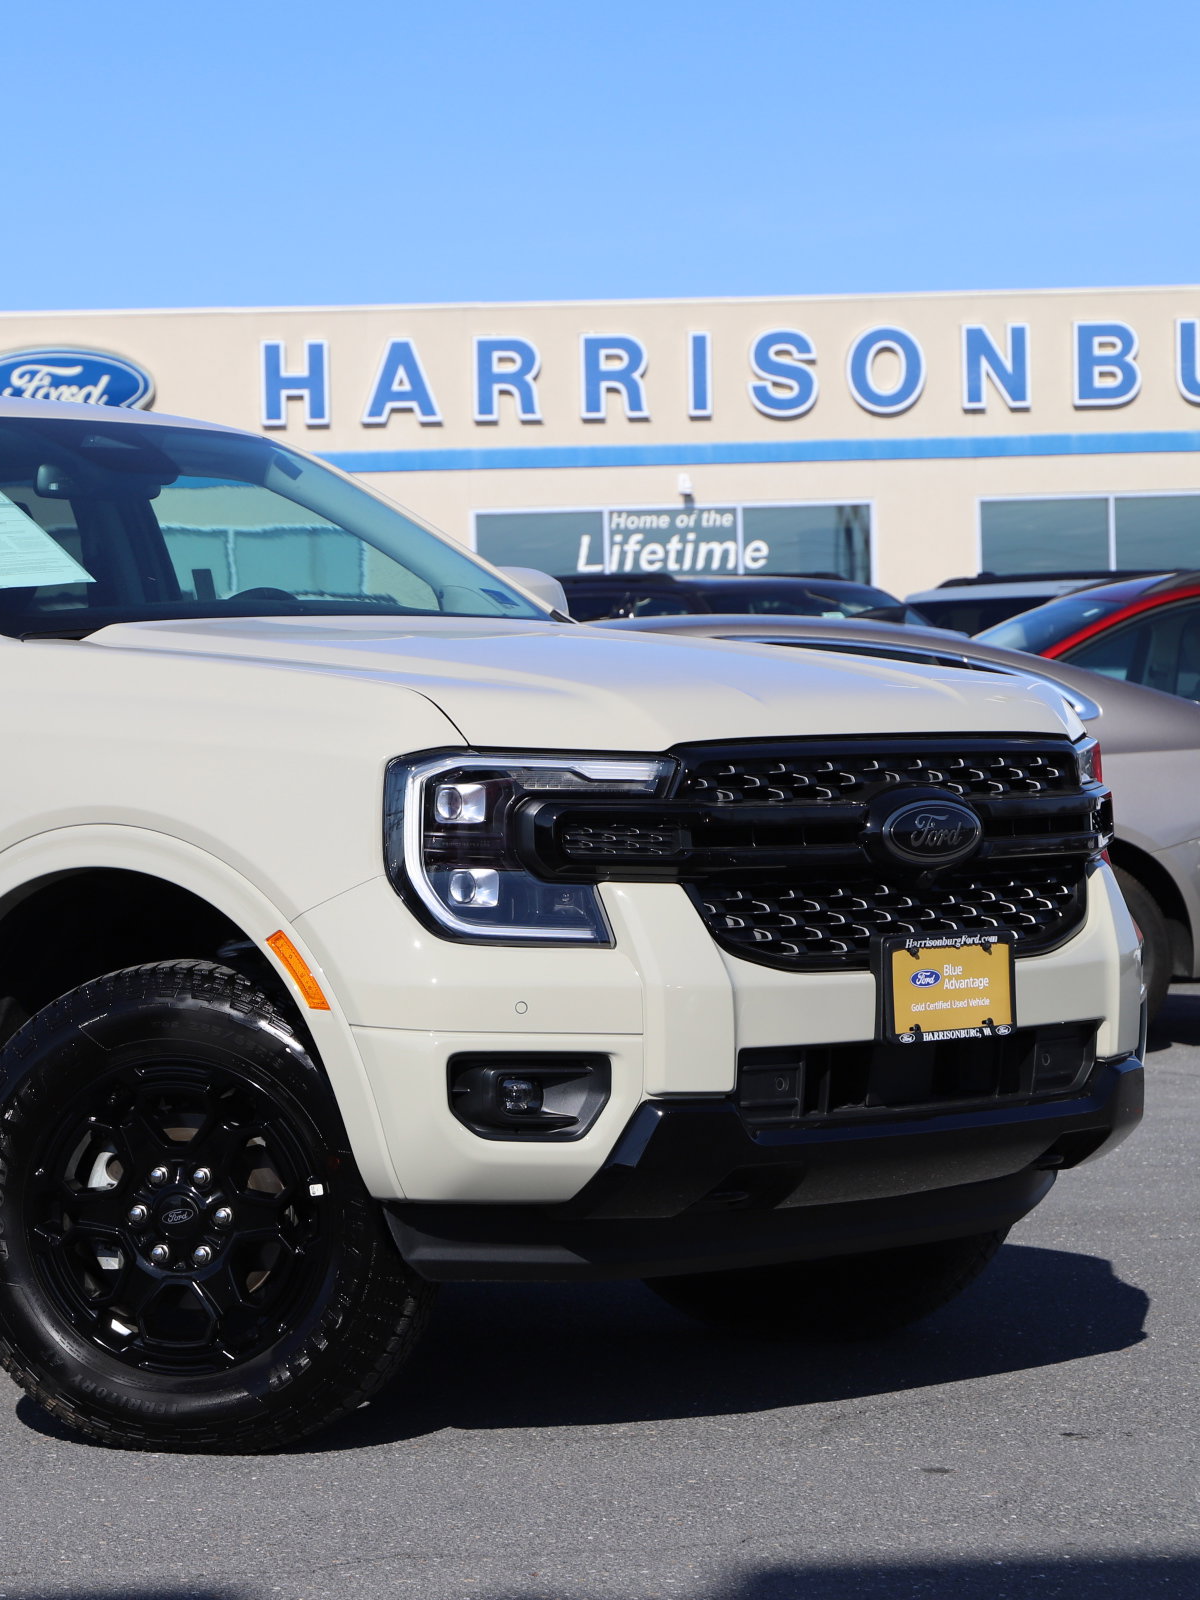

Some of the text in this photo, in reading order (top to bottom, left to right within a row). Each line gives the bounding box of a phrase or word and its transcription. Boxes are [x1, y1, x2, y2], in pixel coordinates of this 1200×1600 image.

[610, 509, 734, 530] Home of the
[576, 532, 770, 573] Lifetime
[910, 813, 962, 847] Ford
[943, 963, 963, 976] Blue
[915, 971, 936, 985] Ford
[943, 976, 990, 990] Advantage
[911, 997, 990, 1012] Gold Certified Used Vehicle
[923, 1027, 992, 1041] HARRISONBURG, VA
